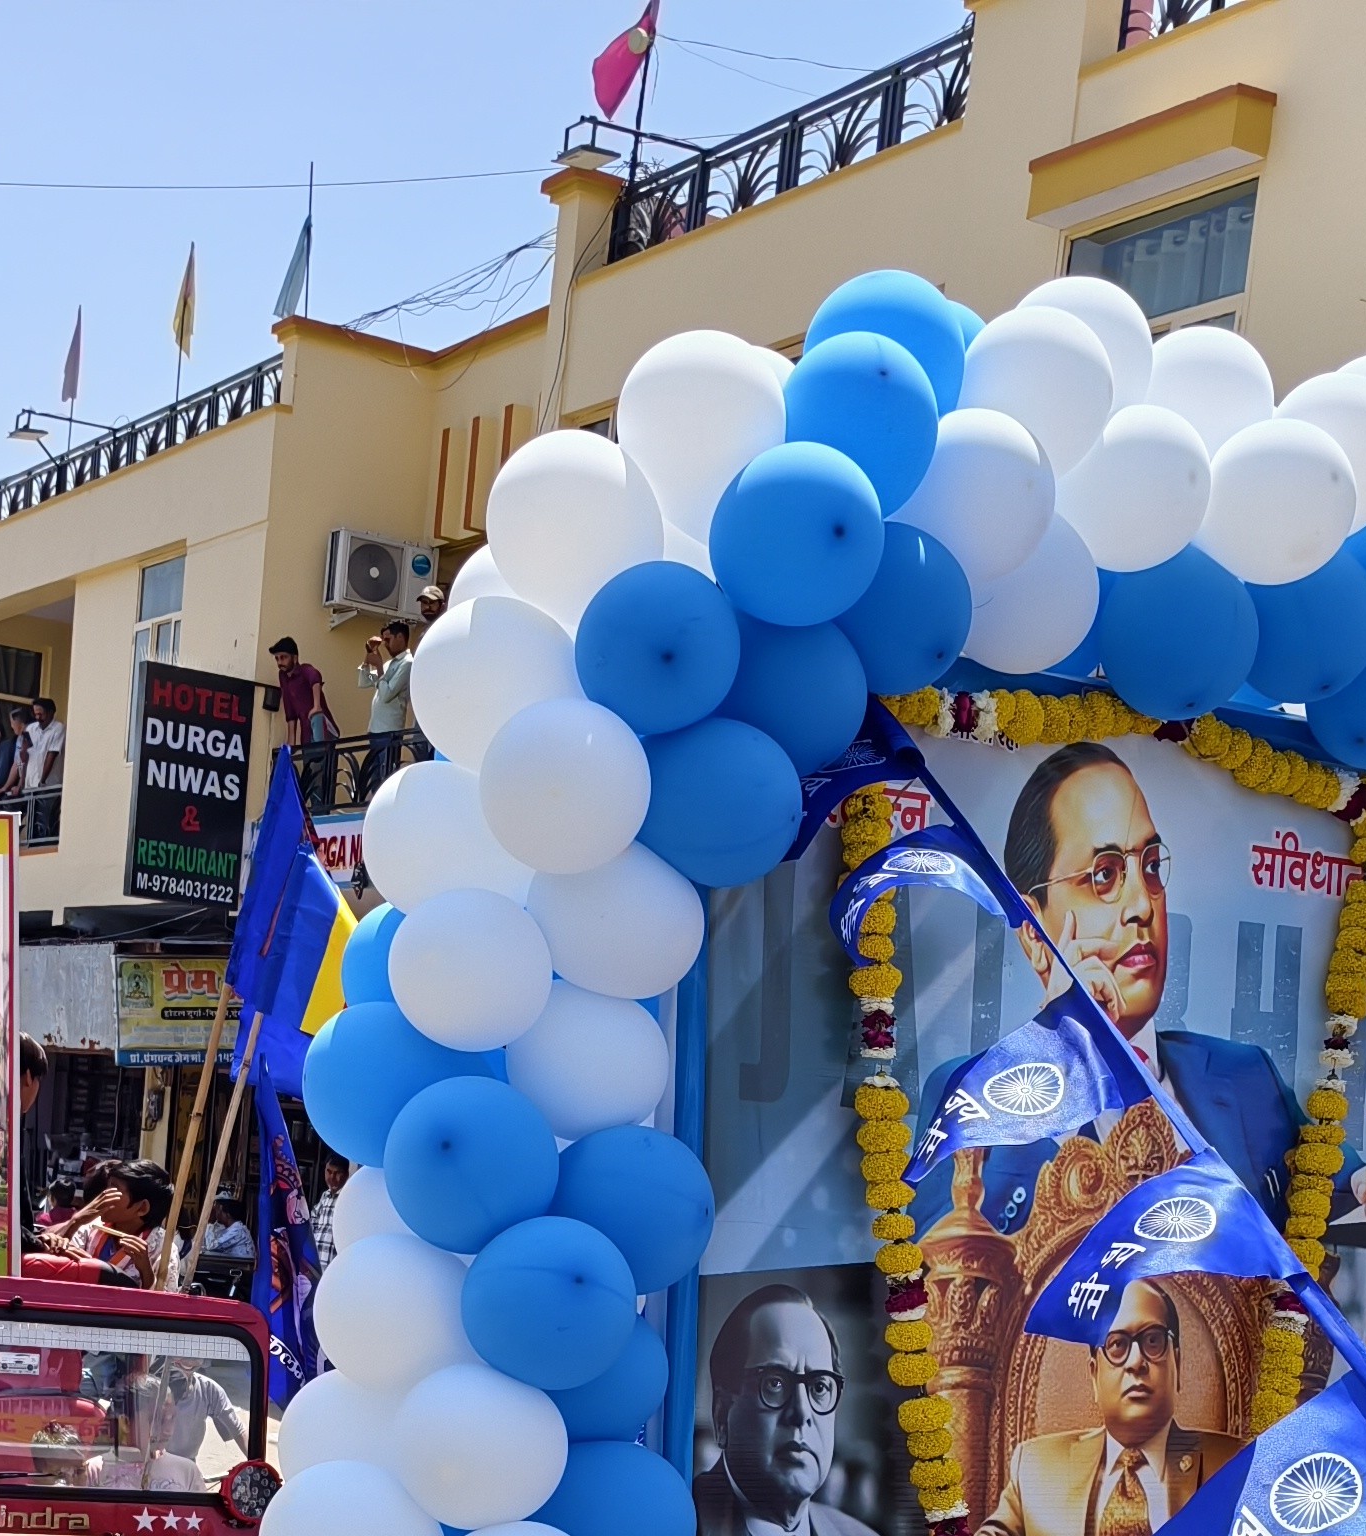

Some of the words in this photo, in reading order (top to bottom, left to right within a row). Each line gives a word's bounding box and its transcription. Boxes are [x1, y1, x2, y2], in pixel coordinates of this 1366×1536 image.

[153, 678, 247, 723] HOTEL
[145, 717, 246, 763] DURGA
[147, 759, 240, 801] NIWAS
[180, 806, 201, 832] &
[137, 838, 237, 880] RESTAURANT
[136, 872, 235, 904] M-9784031222
[163, 961, 218, 996] प्रेम
[944, 1088, 992, 1124] जय
[1101, 1242, 1147, 1271] जय
[1067, 1272, 1111, 1320] भीम
